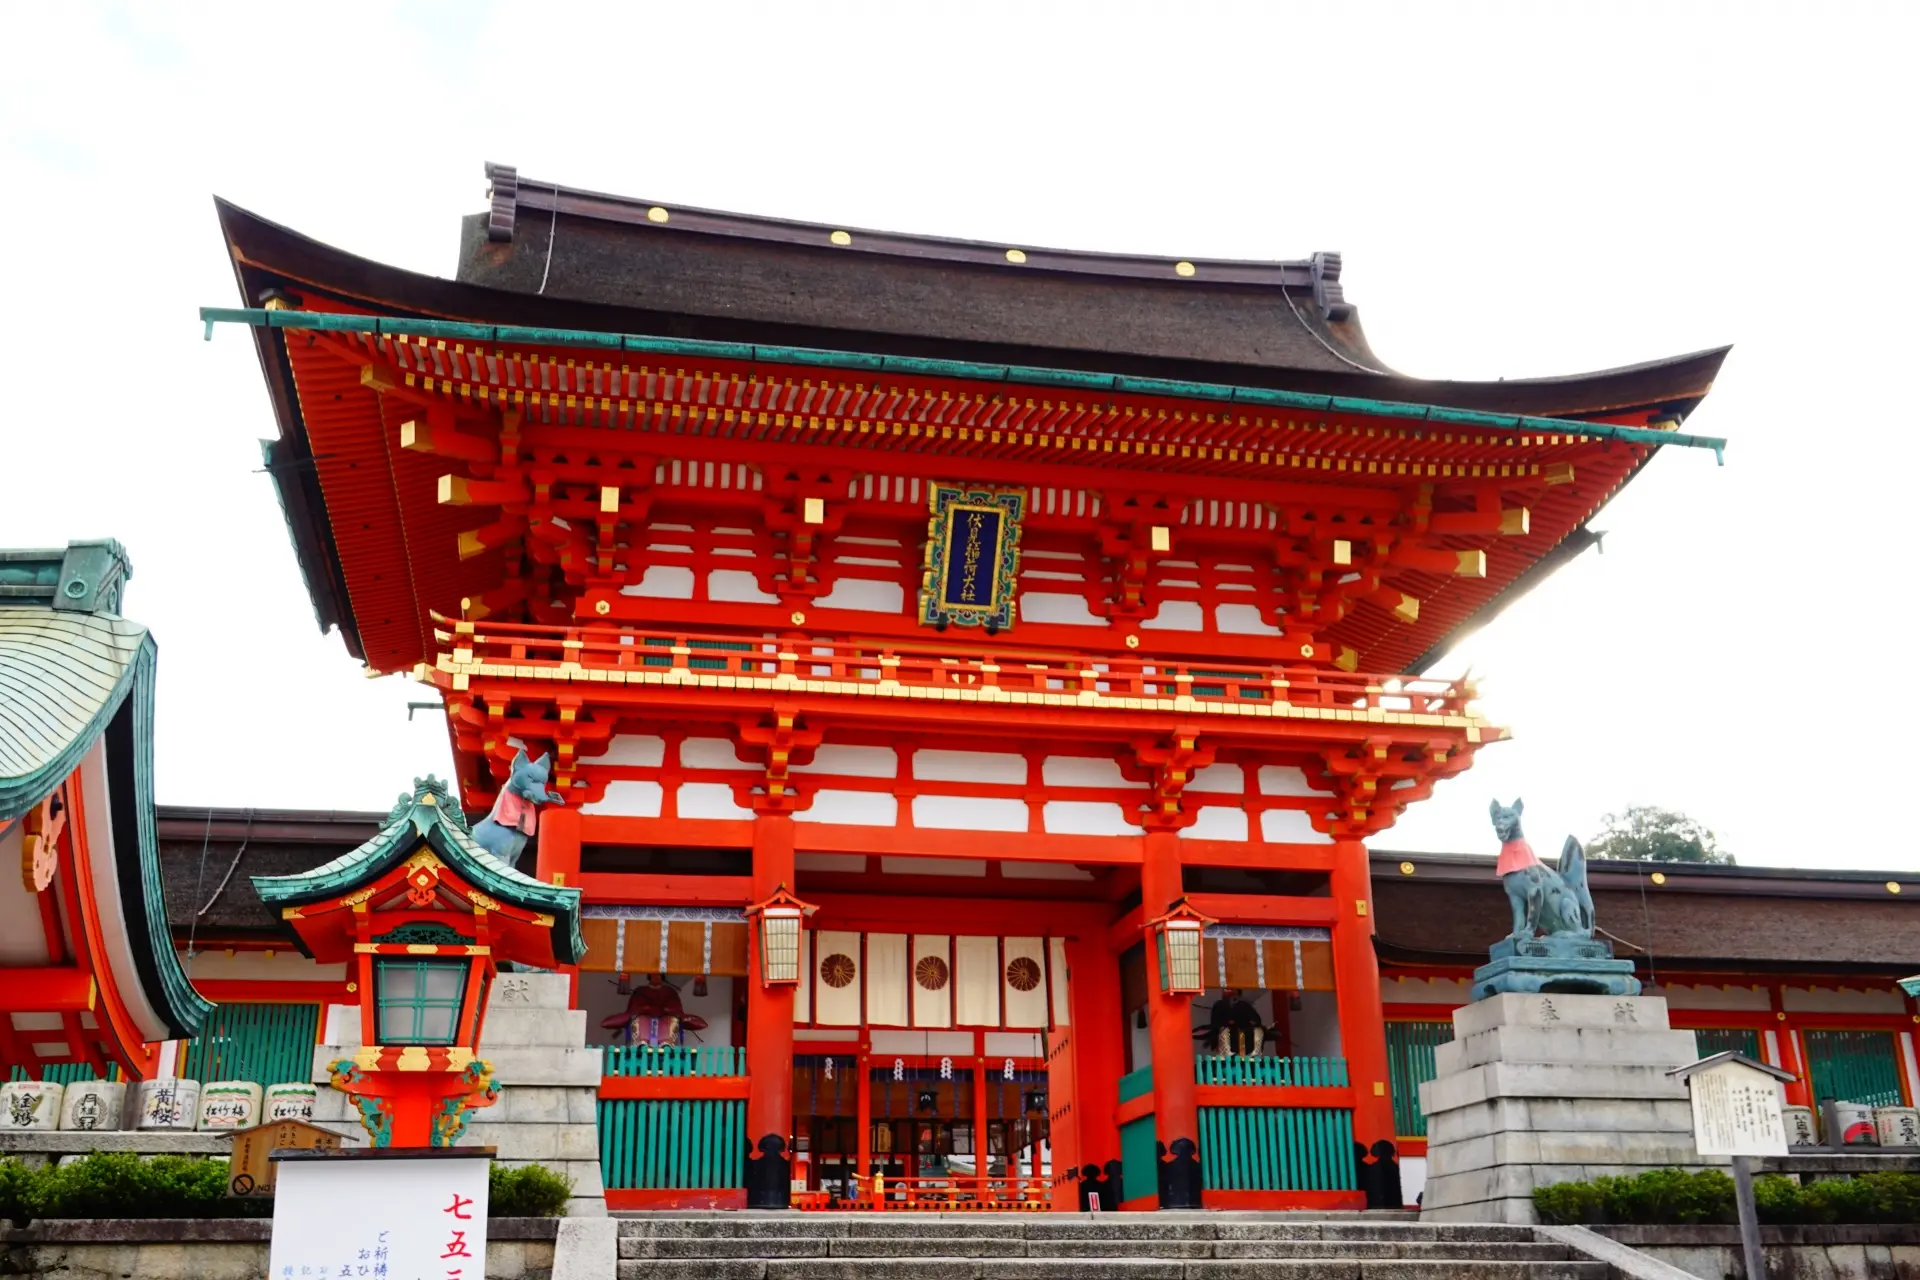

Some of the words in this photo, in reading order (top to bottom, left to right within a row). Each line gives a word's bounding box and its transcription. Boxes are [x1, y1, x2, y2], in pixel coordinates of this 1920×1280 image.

[960, 513, 985, 602] 伏見稲荷大社
[79, 1093, 97, 1130] 月桂冠
[206, 1103, 245, 1117] 松竹梅
[273, 1104, 313, 1118] 松竹梅
[374, 1230, 390, 1280] ご祈祷
